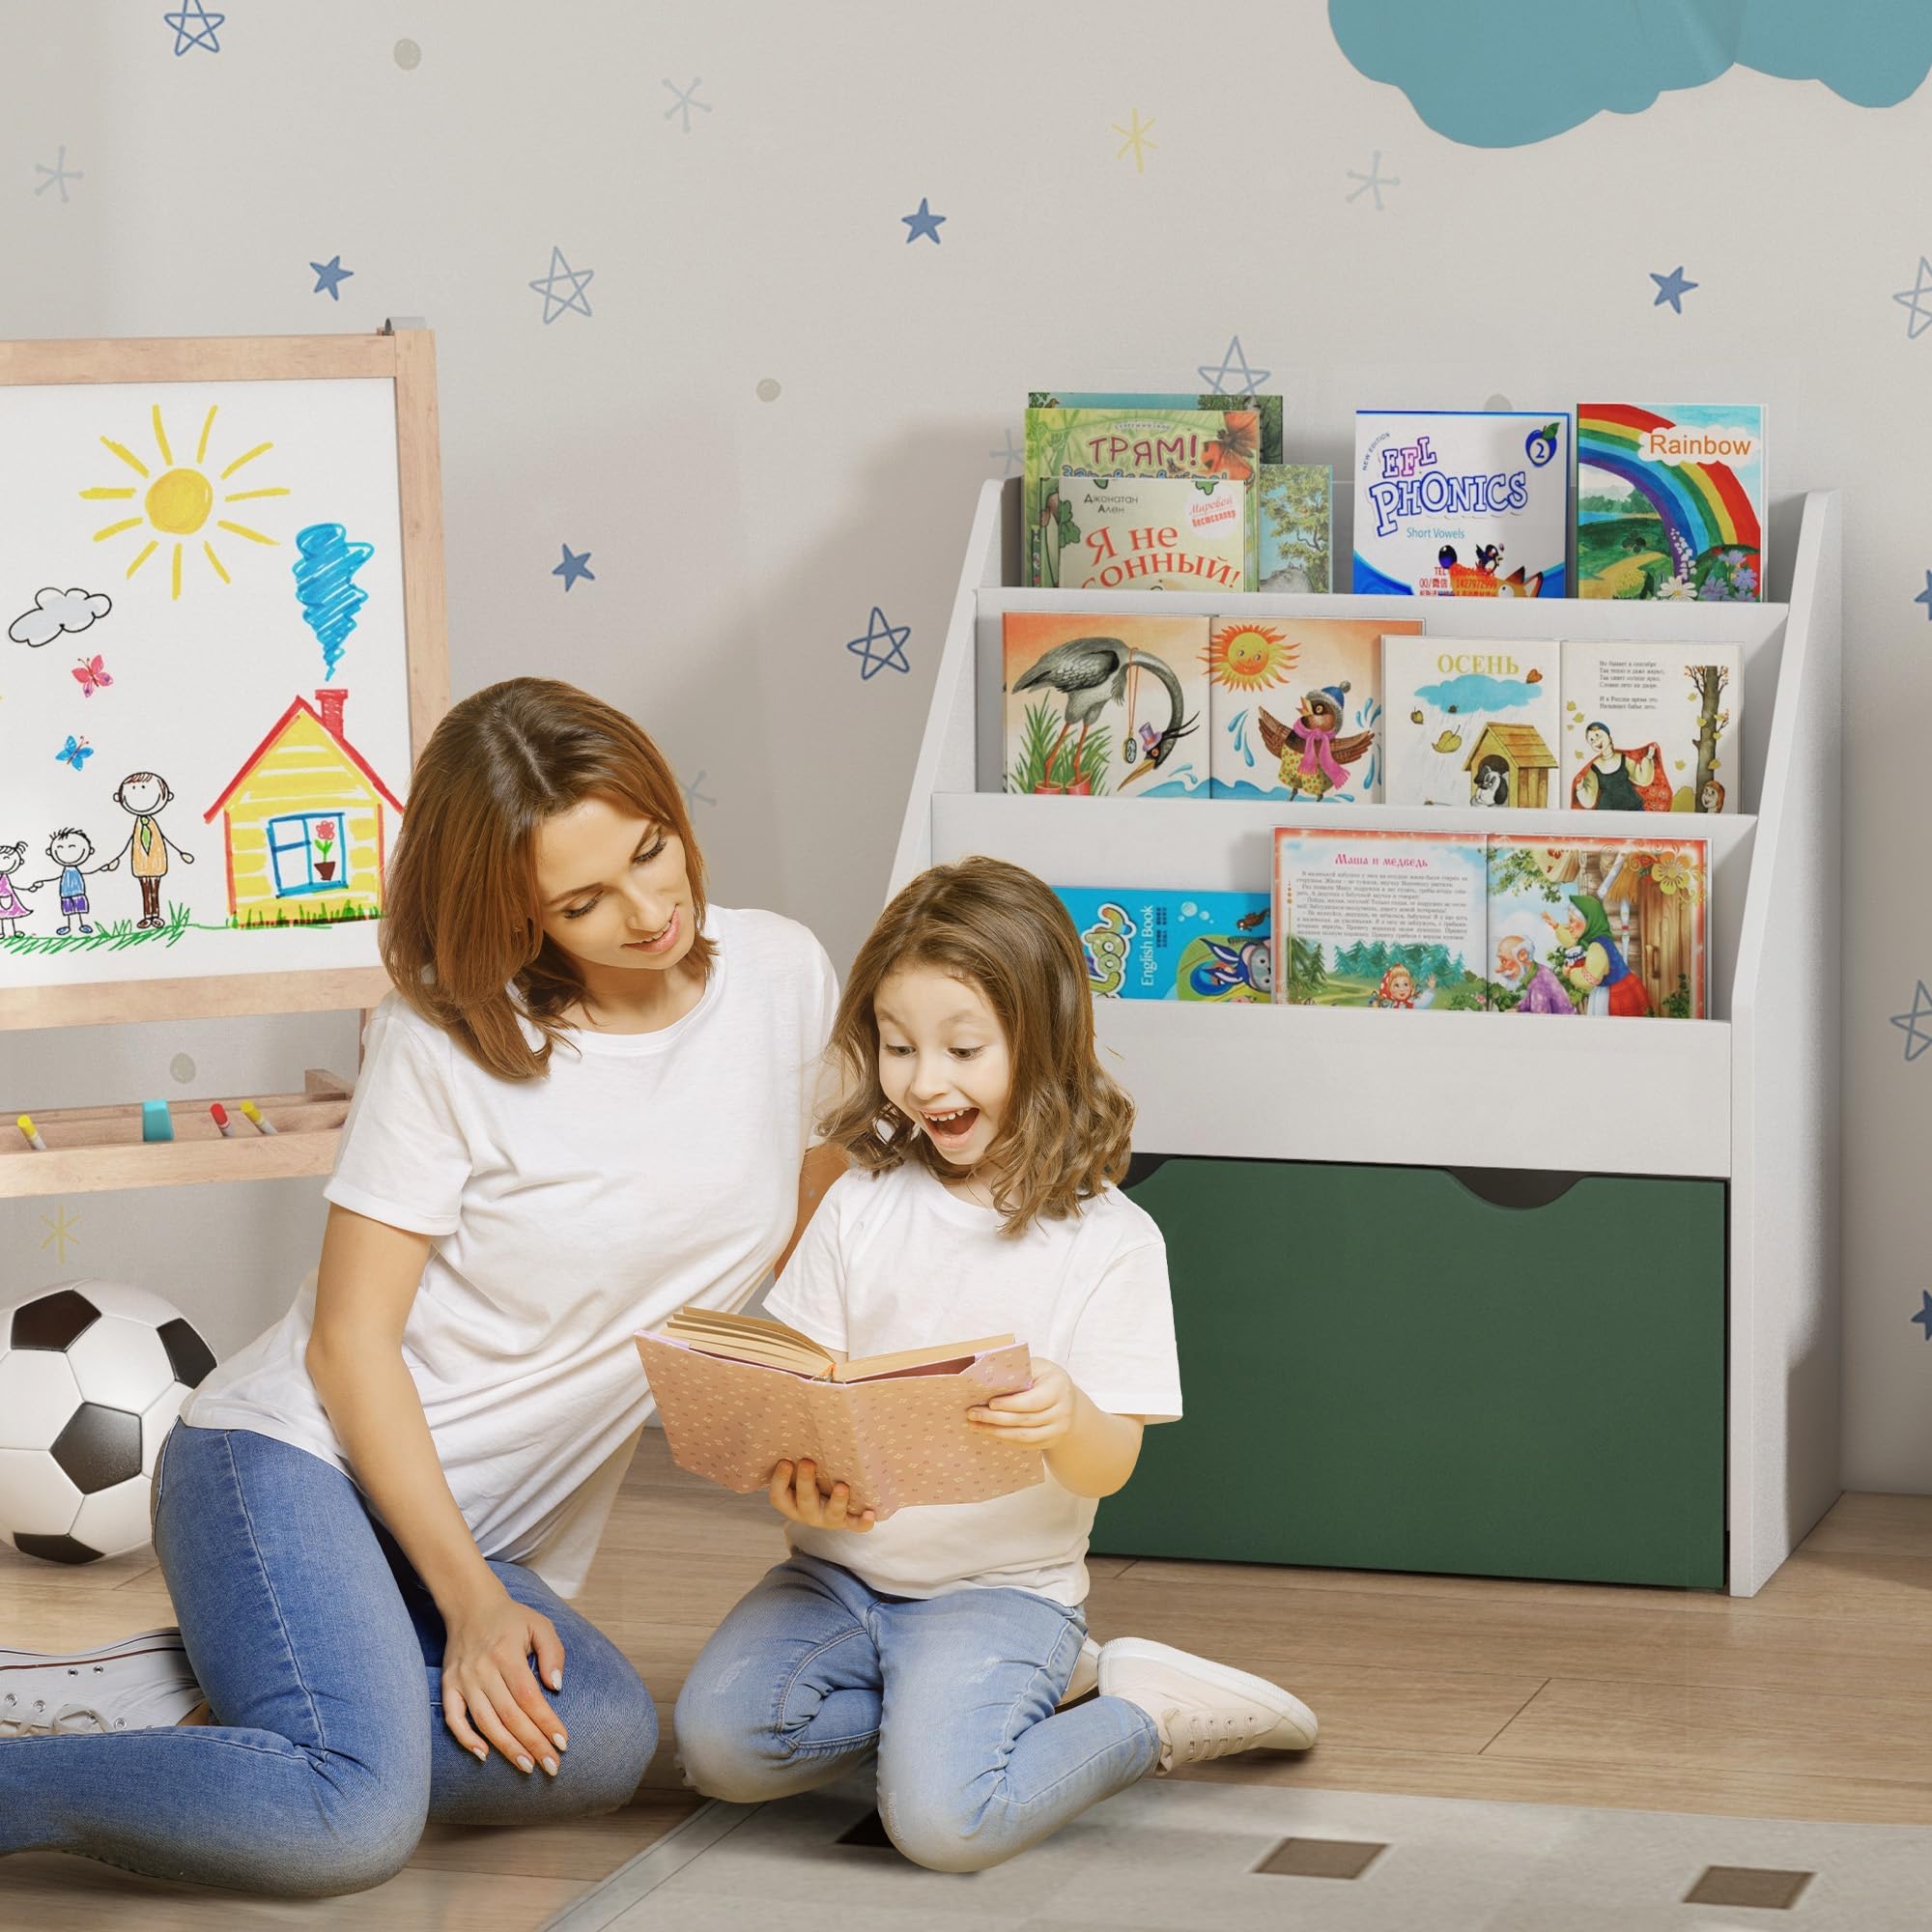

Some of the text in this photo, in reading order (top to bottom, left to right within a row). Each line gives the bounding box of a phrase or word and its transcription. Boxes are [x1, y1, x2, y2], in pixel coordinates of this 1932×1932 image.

[1088, 434, 1198, 467] ТРЯМ!
[1362, 432, 1391, 471] NEW EDITION
[1382, 437, 1438, 479] EFL
[1535, 441, 1545, 459] 2
[1649, 434, 1751, 456] Rainbow
[1083, 494, 1139, 504] Джонатан
[1369, 470, 1529, 538] PHONICS
[1406, 526, 1465, 539] Short Vowels
[1085, 526, 1179, 567] Я не
[1436, 654, 1520, 674] ОСЕНЬ
[1335, 853, 1429, 868] Маша и медведь
[1139, 904, 1157, 986] English Book
